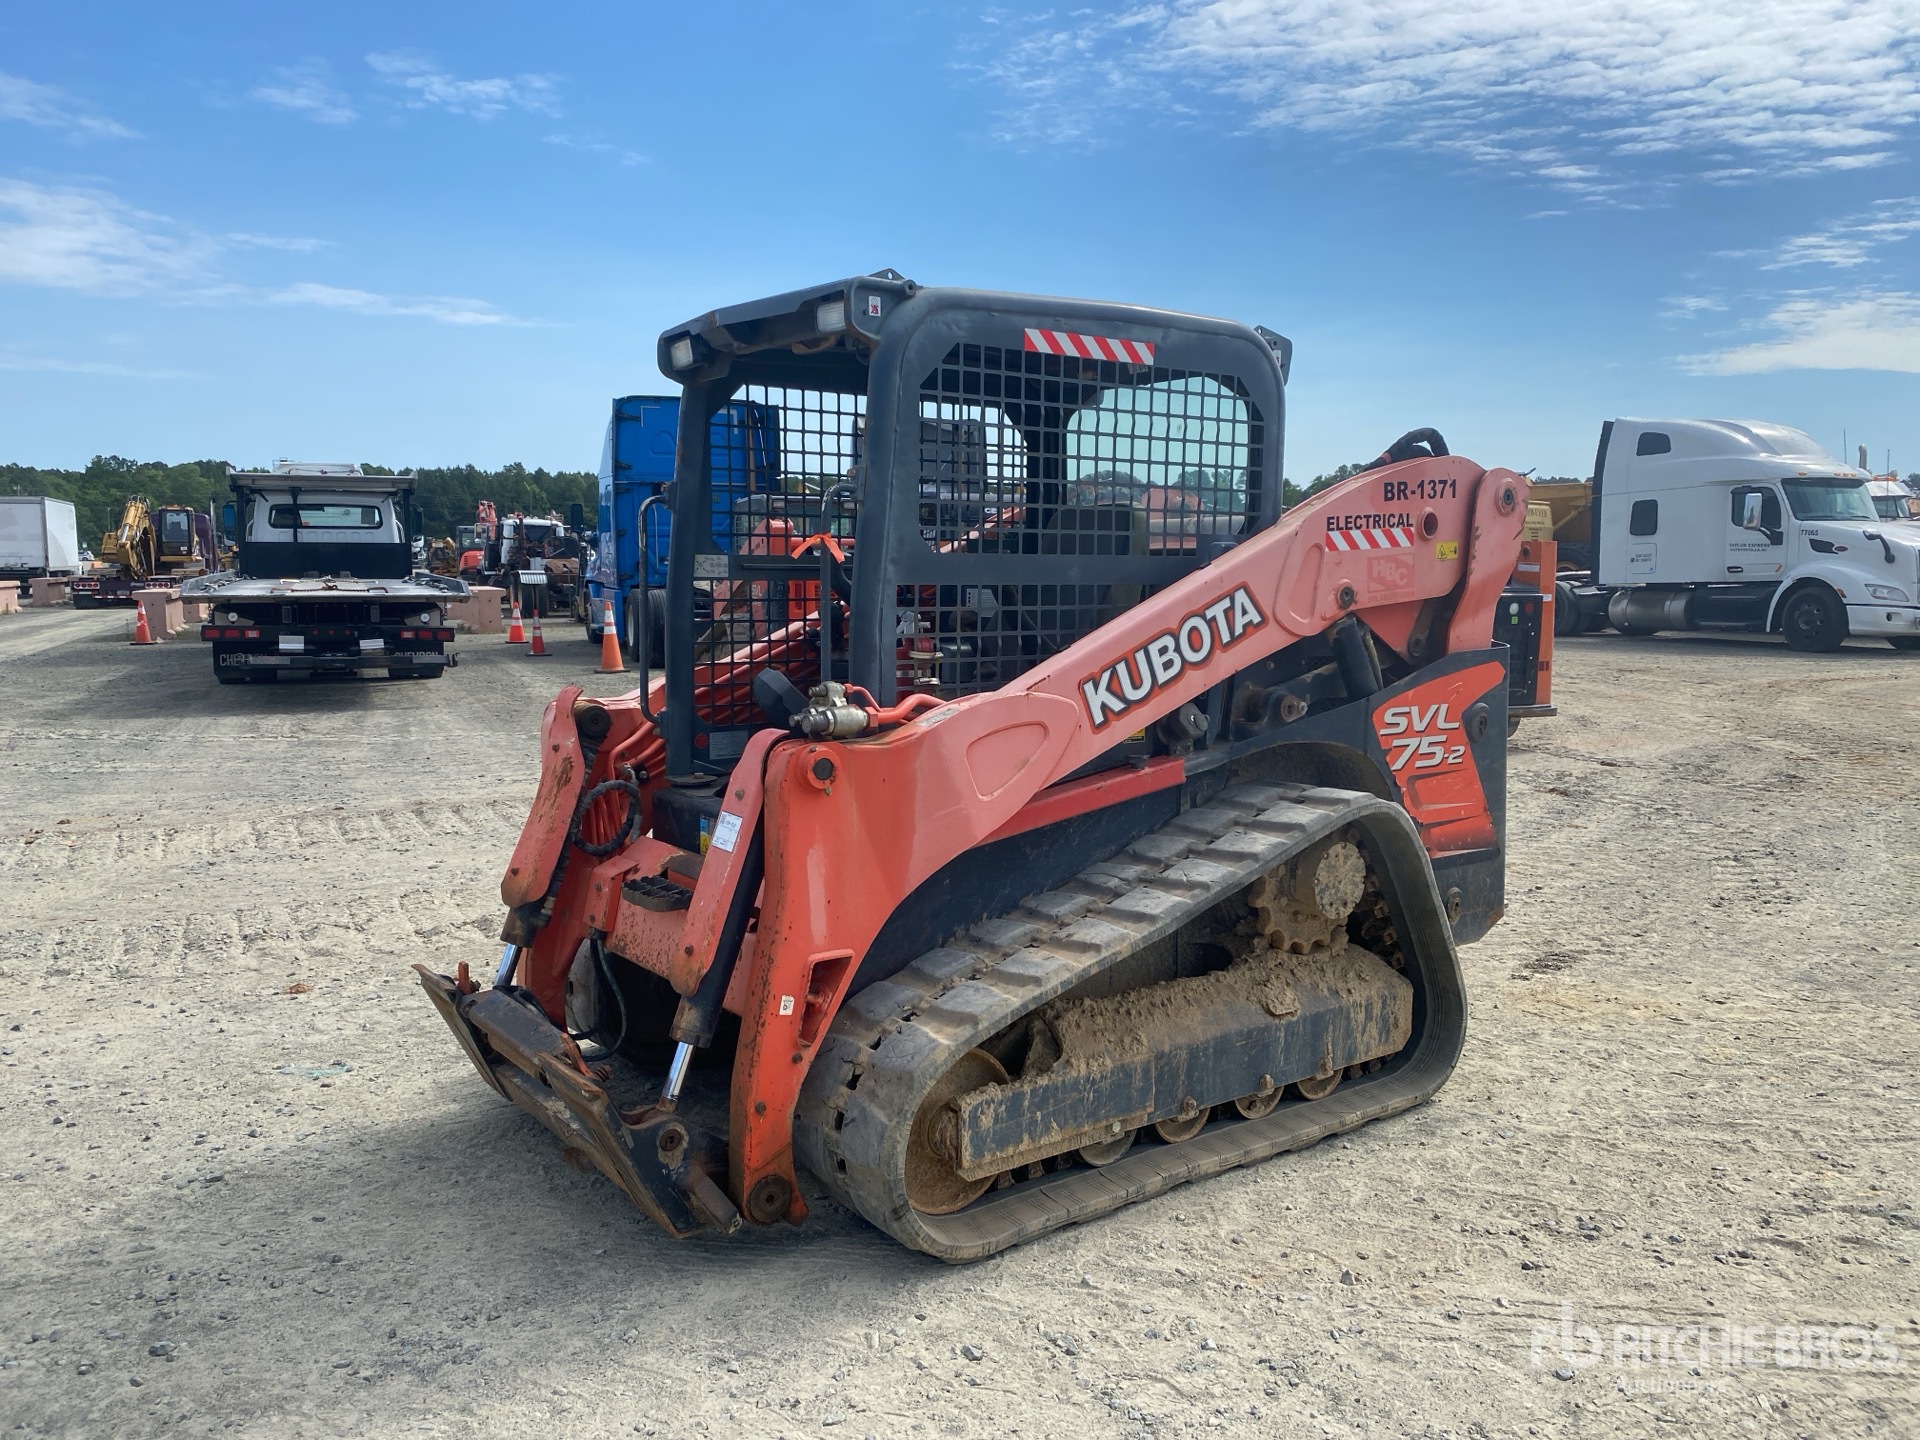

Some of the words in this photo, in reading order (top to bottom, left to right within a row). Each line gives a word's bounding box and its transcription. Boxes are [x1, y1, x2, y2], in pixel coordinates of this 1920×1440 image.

[1383, 478, 1457, 502] BR-1371
[1326, 512, 1414, 532] ELECTRICAL
[1082, 587, 1264, 728] KUBOTA
[1379, 703, 1461, 736] SVL
[1390, 734, 1466, 771] 75-2
